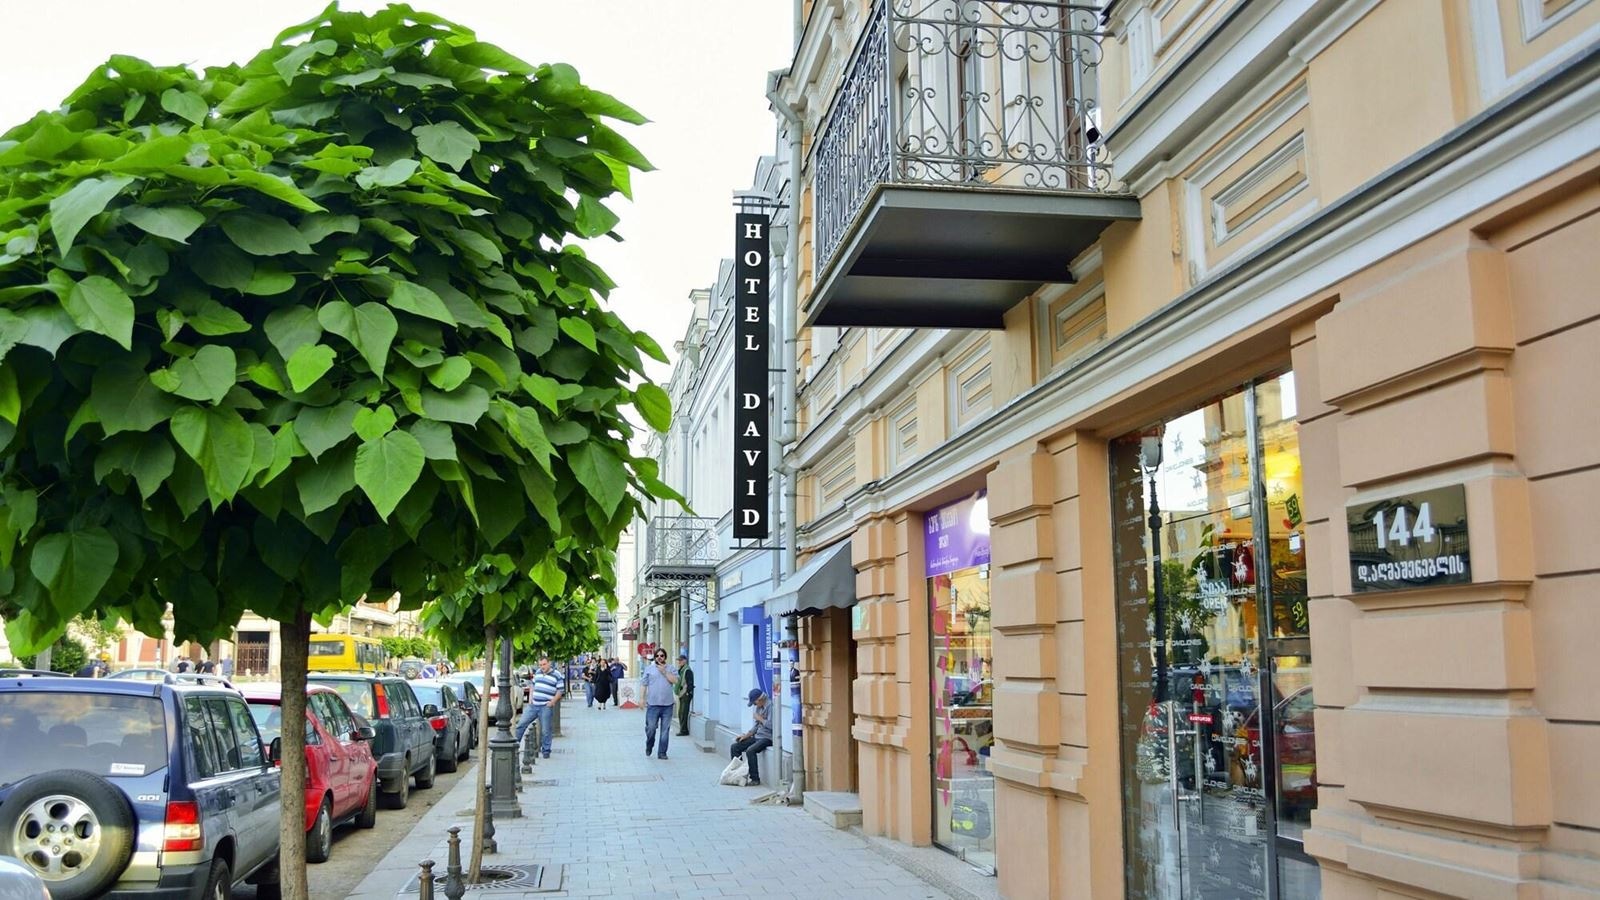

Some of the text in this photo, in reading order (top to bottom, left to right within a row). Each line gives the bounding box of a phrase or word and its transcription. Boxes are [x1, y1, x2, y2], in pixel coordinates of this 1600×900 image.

[742, 223, 762, 526] HOTEL DAVID
[1287, 498, 1298, 517] 59
[1373, 502, 1434, 549] 144
[1358, 555, 1464, 582] დ.აღმაშენებლის
[1203, 597, 1228, 609] OPEN
[1292, 601, 1303, 620] 59
